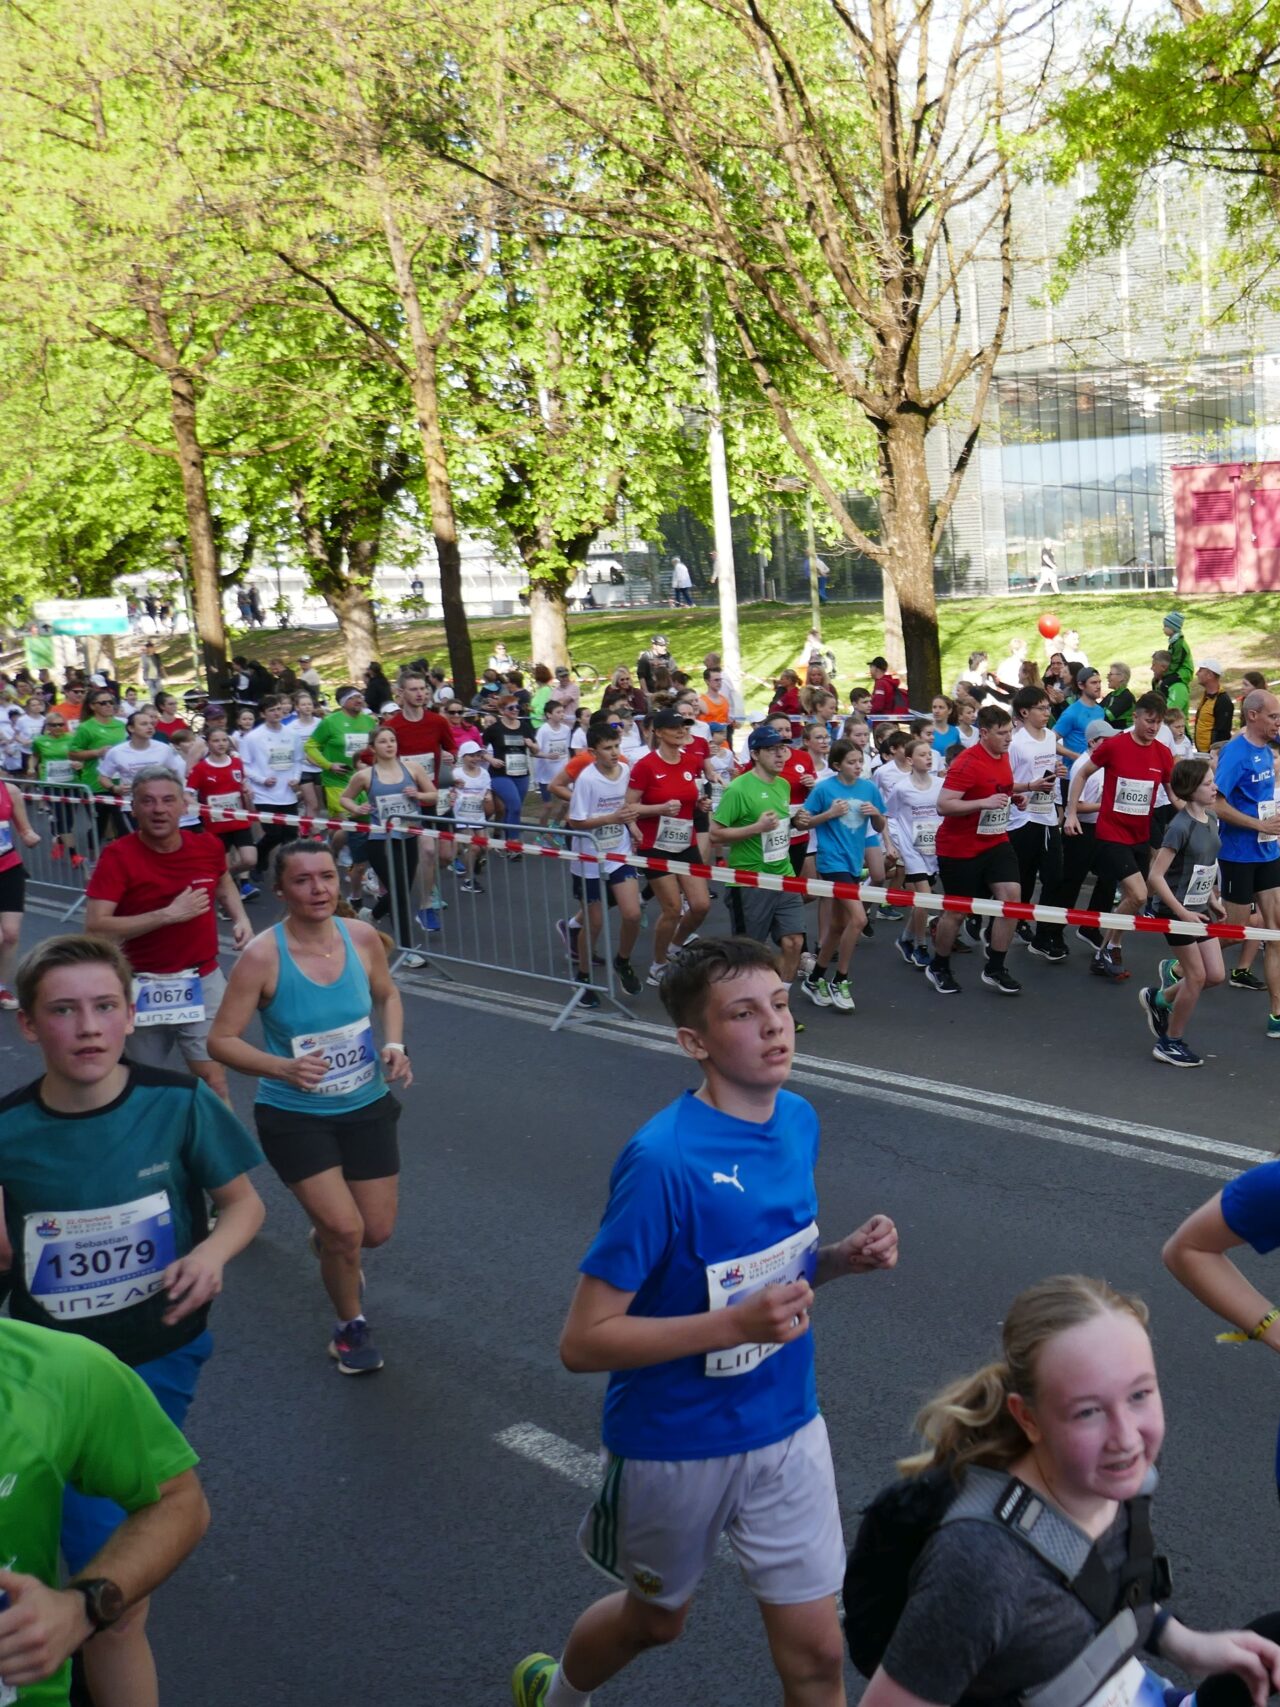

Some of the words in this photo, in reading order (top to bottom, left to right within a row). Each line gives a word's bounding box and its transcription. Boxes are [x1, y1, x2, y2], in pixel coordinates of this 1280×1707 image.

[1120, 791, 1148, 803] 16028
[383, 803, 413, 816] 15711
[663, 830, 689, 842] 15196
[918, 834, 936, 843] 169
[142, 988, 194, 1005] 10676
[136, 1012, 174, 1024] LINZ
[177, 1011, 201, 1021] AG
[325, 1045, 368, 1071] 2022
[316, 1079, 351, 1095] INZ
[354, 1071, 373, 1086] AG
[75, 1234, 129, 1250] Sebastian
[47, 1239, 156, 1280] 13079
[123, 1279, 165, 1302] AG
